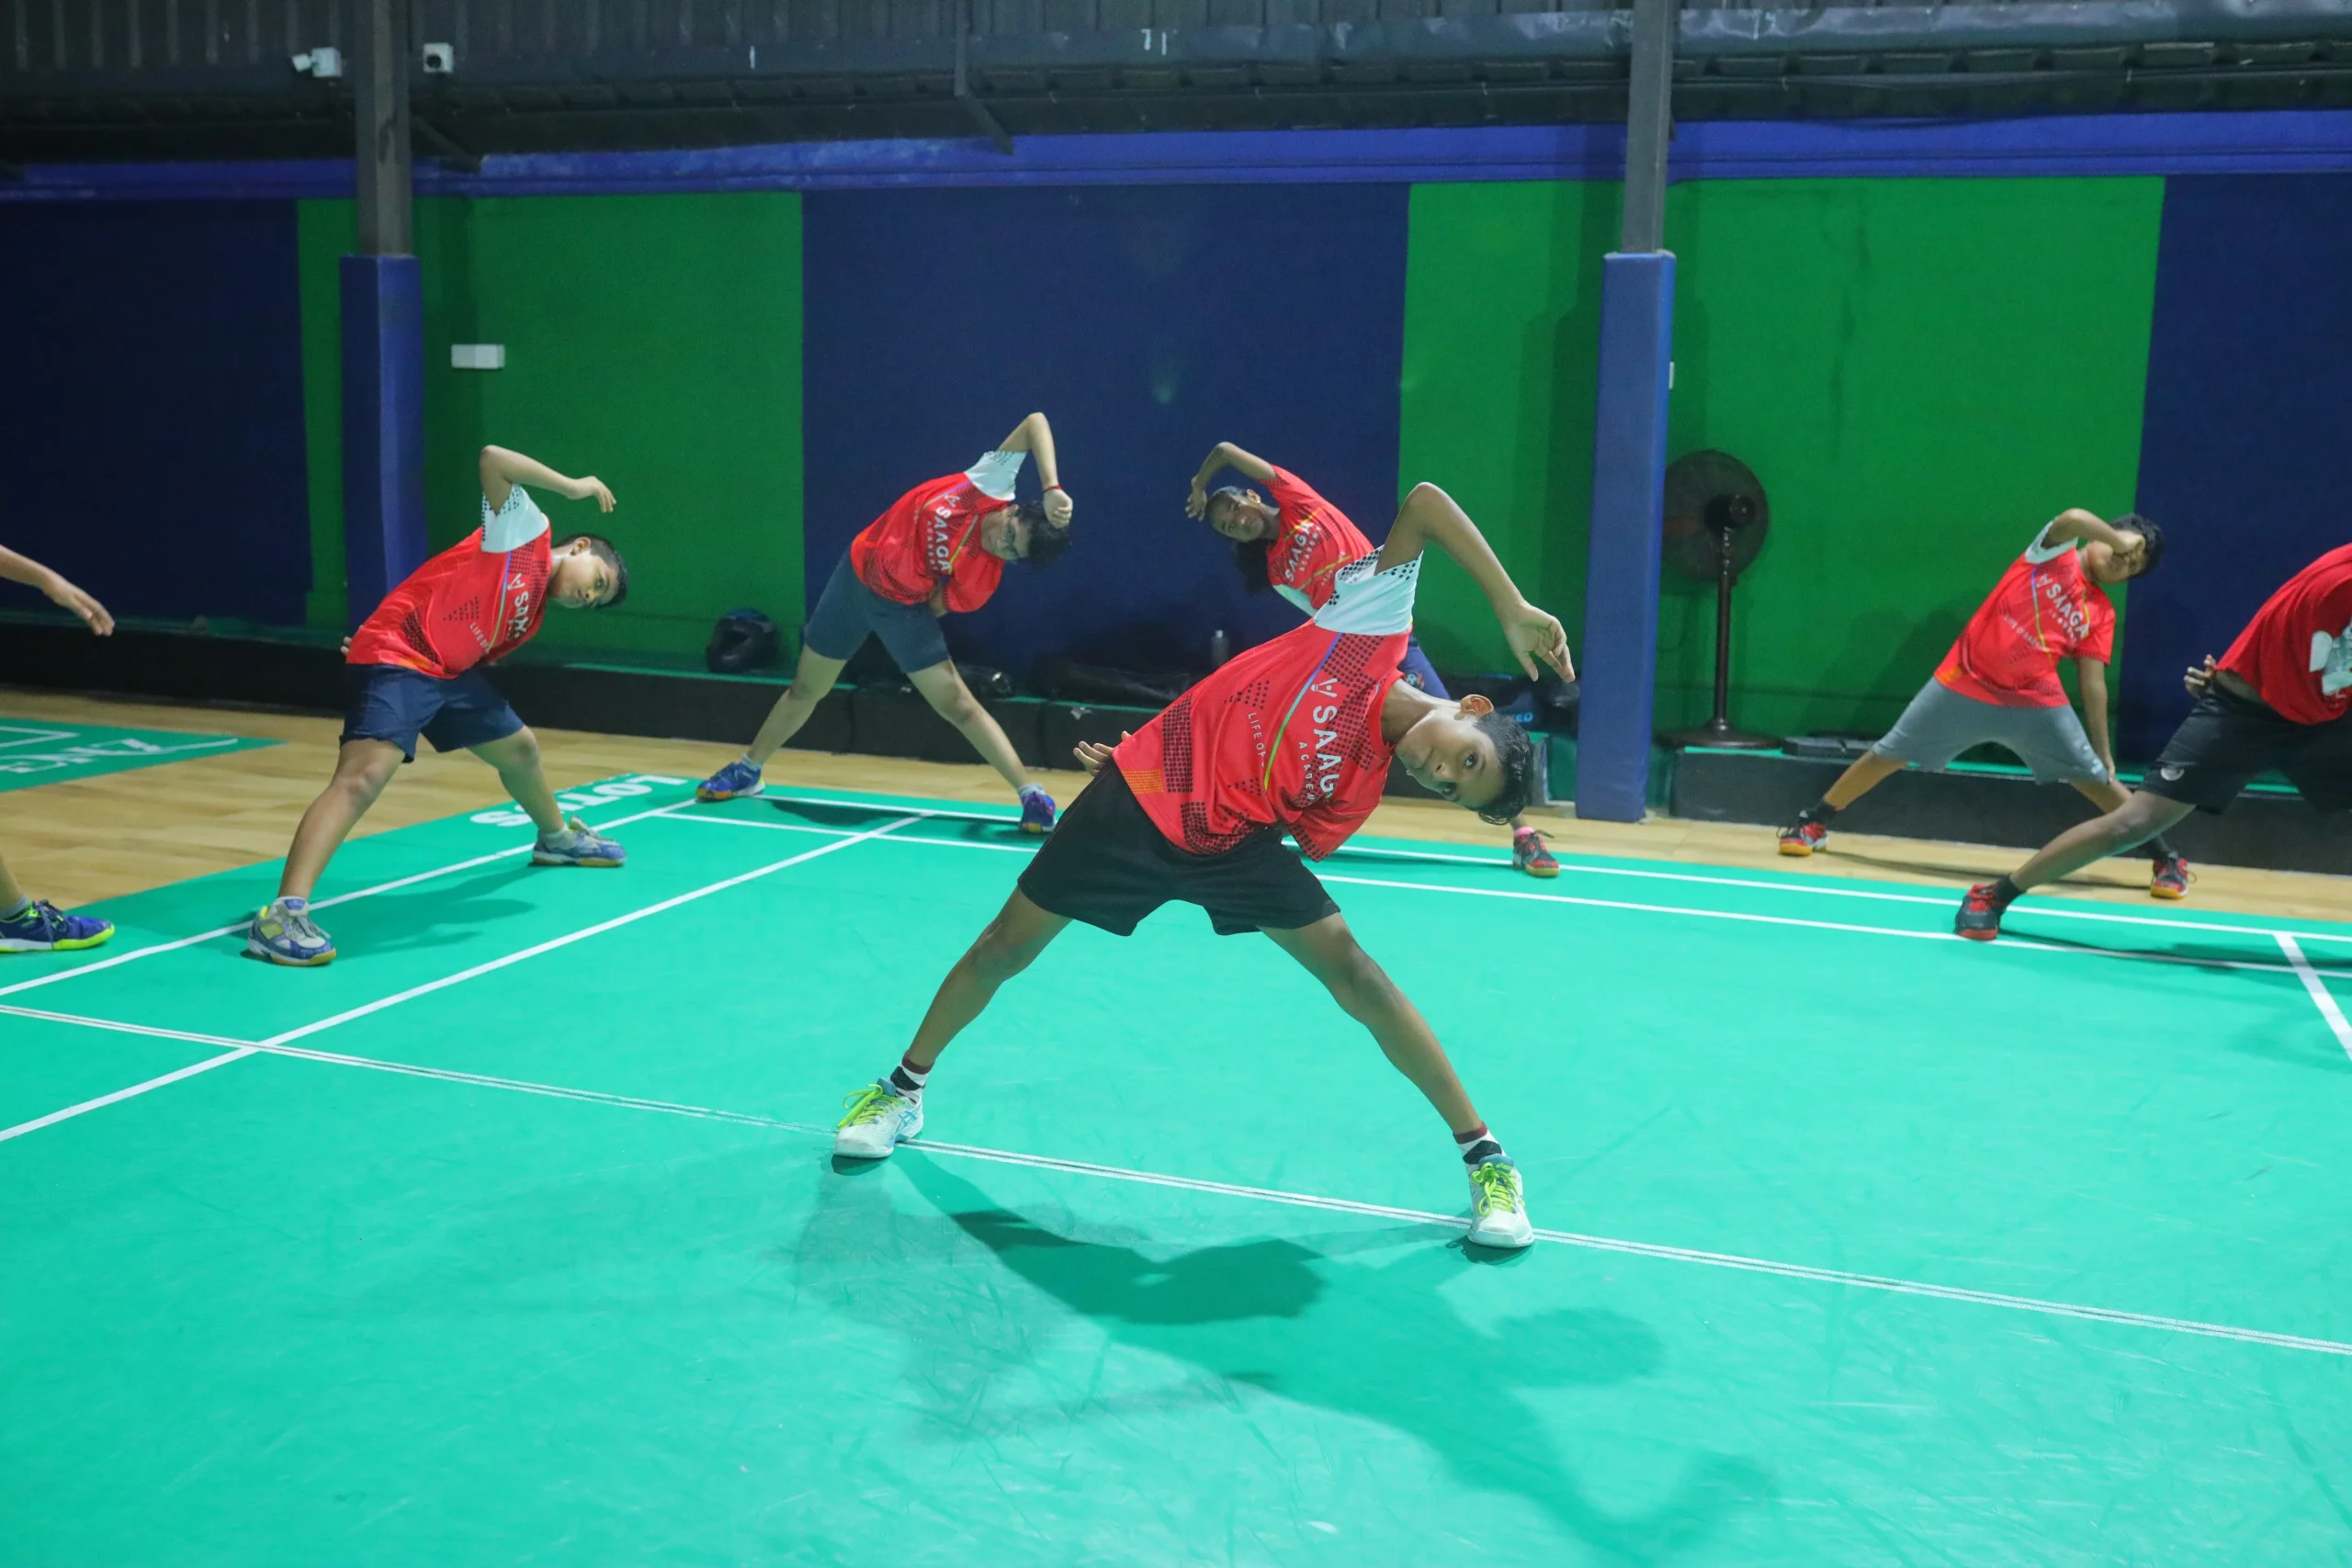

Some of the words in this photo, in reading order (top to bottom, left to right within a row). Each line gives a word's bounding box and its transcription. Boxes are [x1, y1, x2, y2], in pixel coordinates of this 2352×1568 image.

[934, 506, 953, 571] SAAGA
[2046, 583, 2090, 640] SAAGA
[1248, 712, 1262, 739] LIFE
[1313, 705, 1342, 799] SAAG
[1298, 741, 1316, 800] ACADEM
